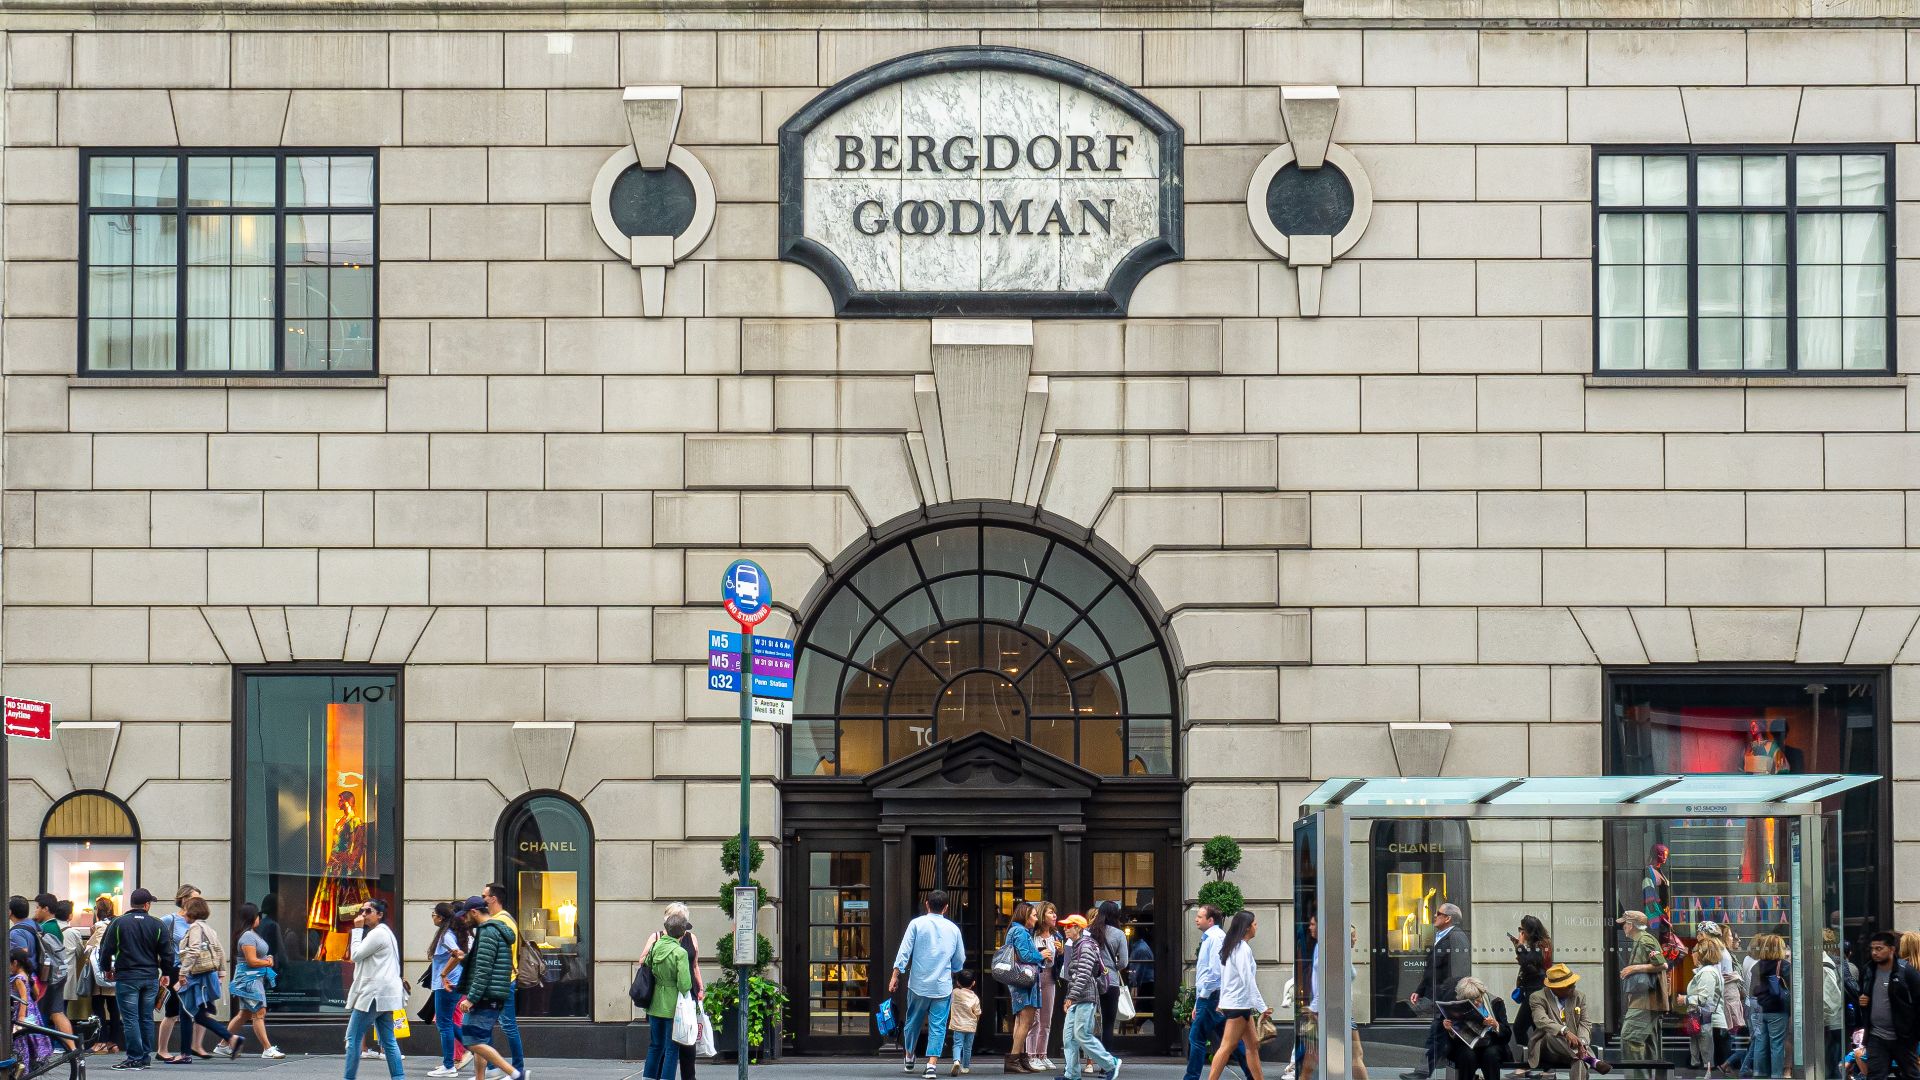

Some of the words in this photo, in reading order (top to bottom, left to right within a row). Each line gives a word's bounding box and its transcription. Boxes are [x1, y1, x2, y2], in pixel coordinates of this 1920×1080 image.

[834, 134, 1134, 172] BERGDORF
[852, 198, 1115, 236] GOODMAN
[728, 602, 738, 613] NO
[737, 607, 768, 622] STANDING
[711, 634, 729, 649] M5
[711, 654, 729, 669] M5
[767, 659, 774, 667] St
[711, 673, 733, 689] Q32
[754, 678, 768, 686] Penn
[769, 680, 788, 688] Station
[7, 701, 16, 709] NO
[17, 702, 44, 712] STANDING
[760, 699, 779, 708] Avenue
[8, 710, 31, 719] Anytime
[754, 706, 768, 714] West
[769, 707, 776, 715] 58
[520, 841, 577, 852] CHANEL
[1388, 843, 1446, 853] CHANEL
